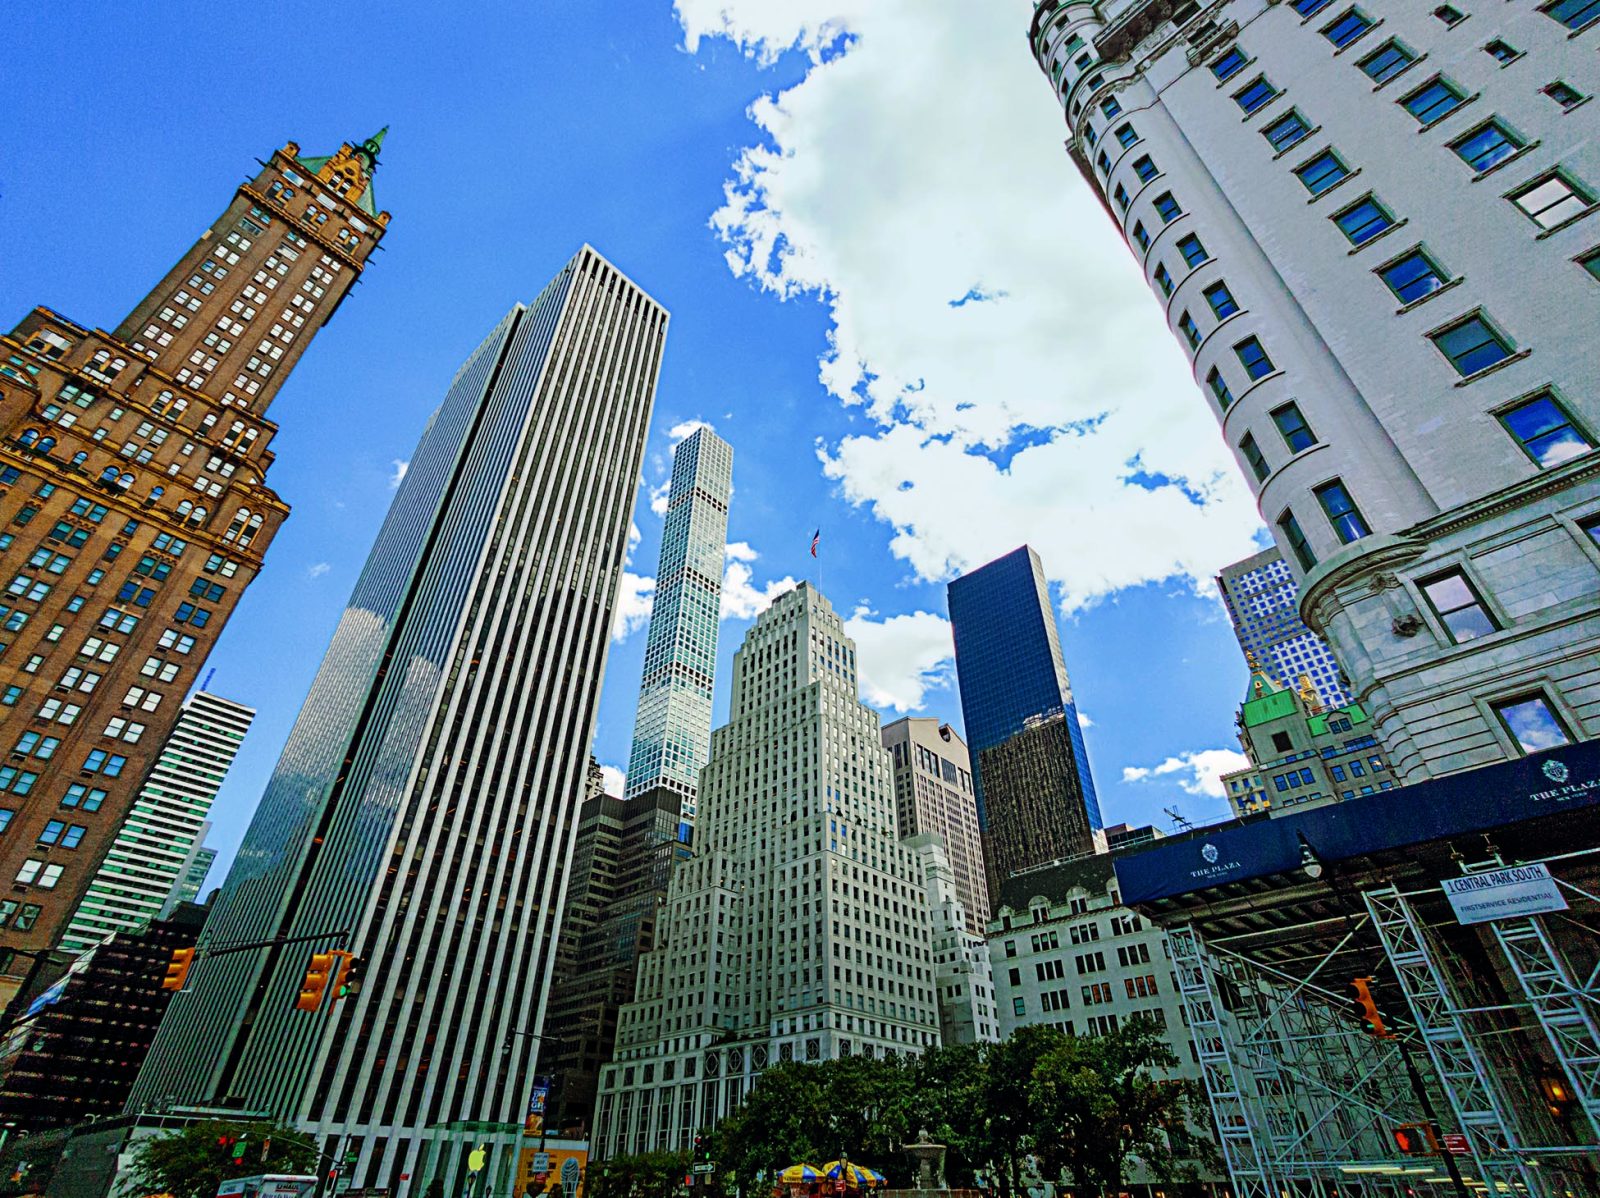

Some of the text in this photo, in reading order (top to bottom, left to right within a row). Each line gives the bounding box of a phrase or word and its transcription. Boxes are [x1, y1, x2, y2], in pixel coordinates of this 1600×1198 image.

[1529, 779, 1600, 801] THE PLAZ
[1190, 868, 1210, 878] THE
[1211, 861, 1241, 872] PLAZA
[1447, 866, 1544, 893] 1 CENTRAL PARK SOUTH
[1460, 898, 1507, 913] FIRSTSERVICE
[1507, 892, 1554, 906] RESIDENTIAL
